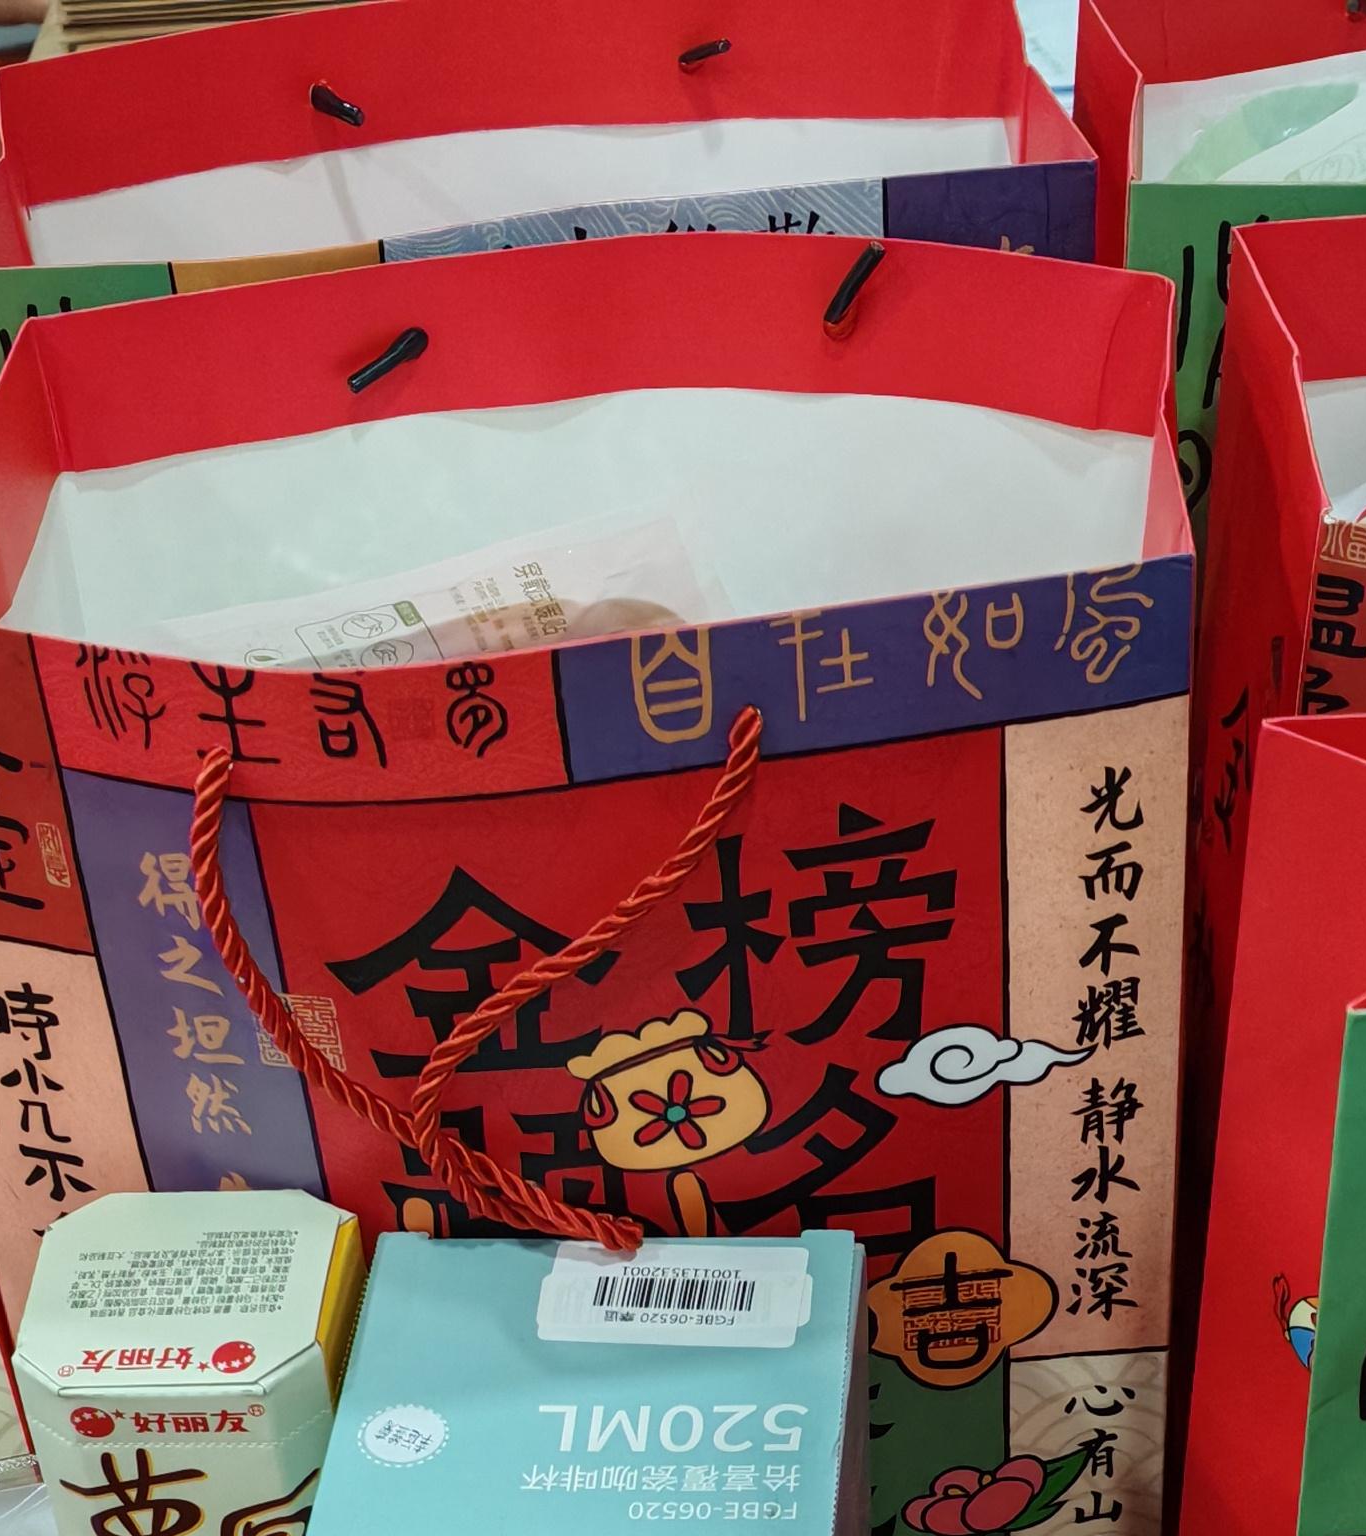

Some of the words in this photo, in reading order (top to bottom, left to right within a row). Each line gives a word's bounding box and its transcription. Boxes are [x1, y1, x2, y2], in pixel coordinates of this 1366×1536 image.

[76, 1347, 194, 1372] 好丽友
[130, 1409, 251, 1433] 好丽友
[538, 1404, 810, 1453] 520ML
[521, 1464, 801, 1494] 拾喜覆瓷咖啡杯
[628, 1502, 797, 1520] FGBE-06520
